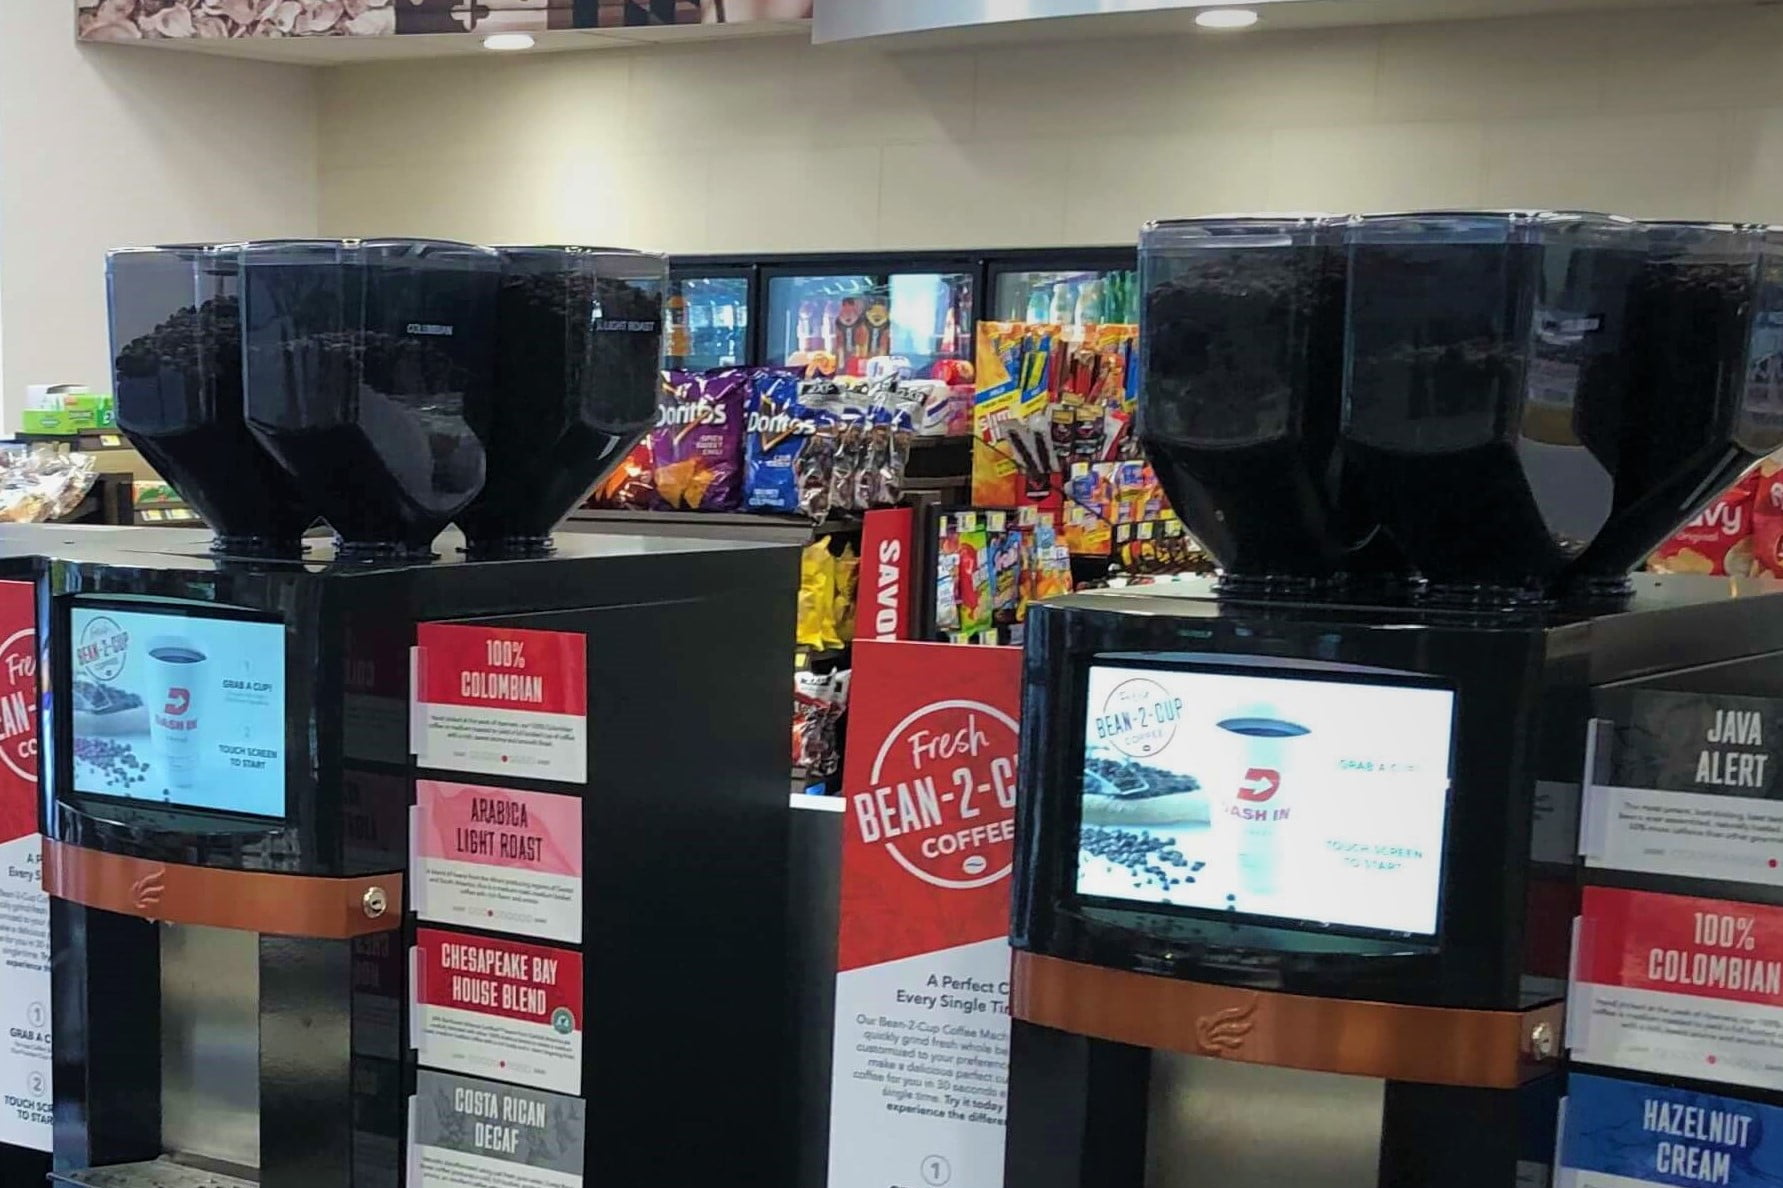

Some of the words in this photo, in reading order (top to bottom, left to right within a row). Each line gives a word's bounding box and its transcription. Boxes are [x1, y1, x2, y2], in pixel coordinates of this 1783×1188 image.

[655, 401, 727, 427] Doritos
[747, 411, 817, 435] Doritos
[1688, 501, 1742, 536] vy
[875, 538, 901, 642] SAVO
[5, 652, 37, 686] Fre
[486, 639, 526, 669] 100%
[461, 671, 543, 703] COLOMBIAN
[1096, 697, 1183, 739] BEAN-2-CUP
[1707, 709, 1762, 746] JAVA
[907, 713, 990, 770] Fresh
[1695, 750, 1768, 787] ALERT
[470, 797, 529, 828] ARABICA
[854, 755, 1017, 844] BEAN-2-C
[1222, 803, 1268, 822] ASH
[456, 827, 496, 856] LIGHT
[500, 832, 543, 862] ROAST
[921, 819, 1014, 859] COFFEE
[1694, 912, 1755, 951] 100%
[441, 943, 529, 981] CHESAPEAKE
[532, 957, 558, 986] BAY
[1648, 948, 1781, 995] COLOMBIAN
[452, 975, 499, 1007] HOUSE
[502, 983, 547, 1015] BLEND
[926, 974, 939, 988] A
[942, 975, 994, 993] Perfect
[896, 989, 937, 1010] Every
[940, 994, 986, 1014] Single
[991, 1000, 1011, 1014] Ti
[455, 1087, 499, 1119] COSTA
[503, 1096, 546, 1128] RICAN
[886, 1102, 946, 1118] experience
[948, 1109, 965, 1120] the
[968, 1111, 1008, 1126] differe
[944, 1094, 960, 1108] Try
[31, 1112, 54, 1126] STAR
[1643, 1099, 1753, 1149] HAZELNUT
[475, 1122, 519, 1153] DECAF
[1656, 1141, 1731, 1185] CREAM
